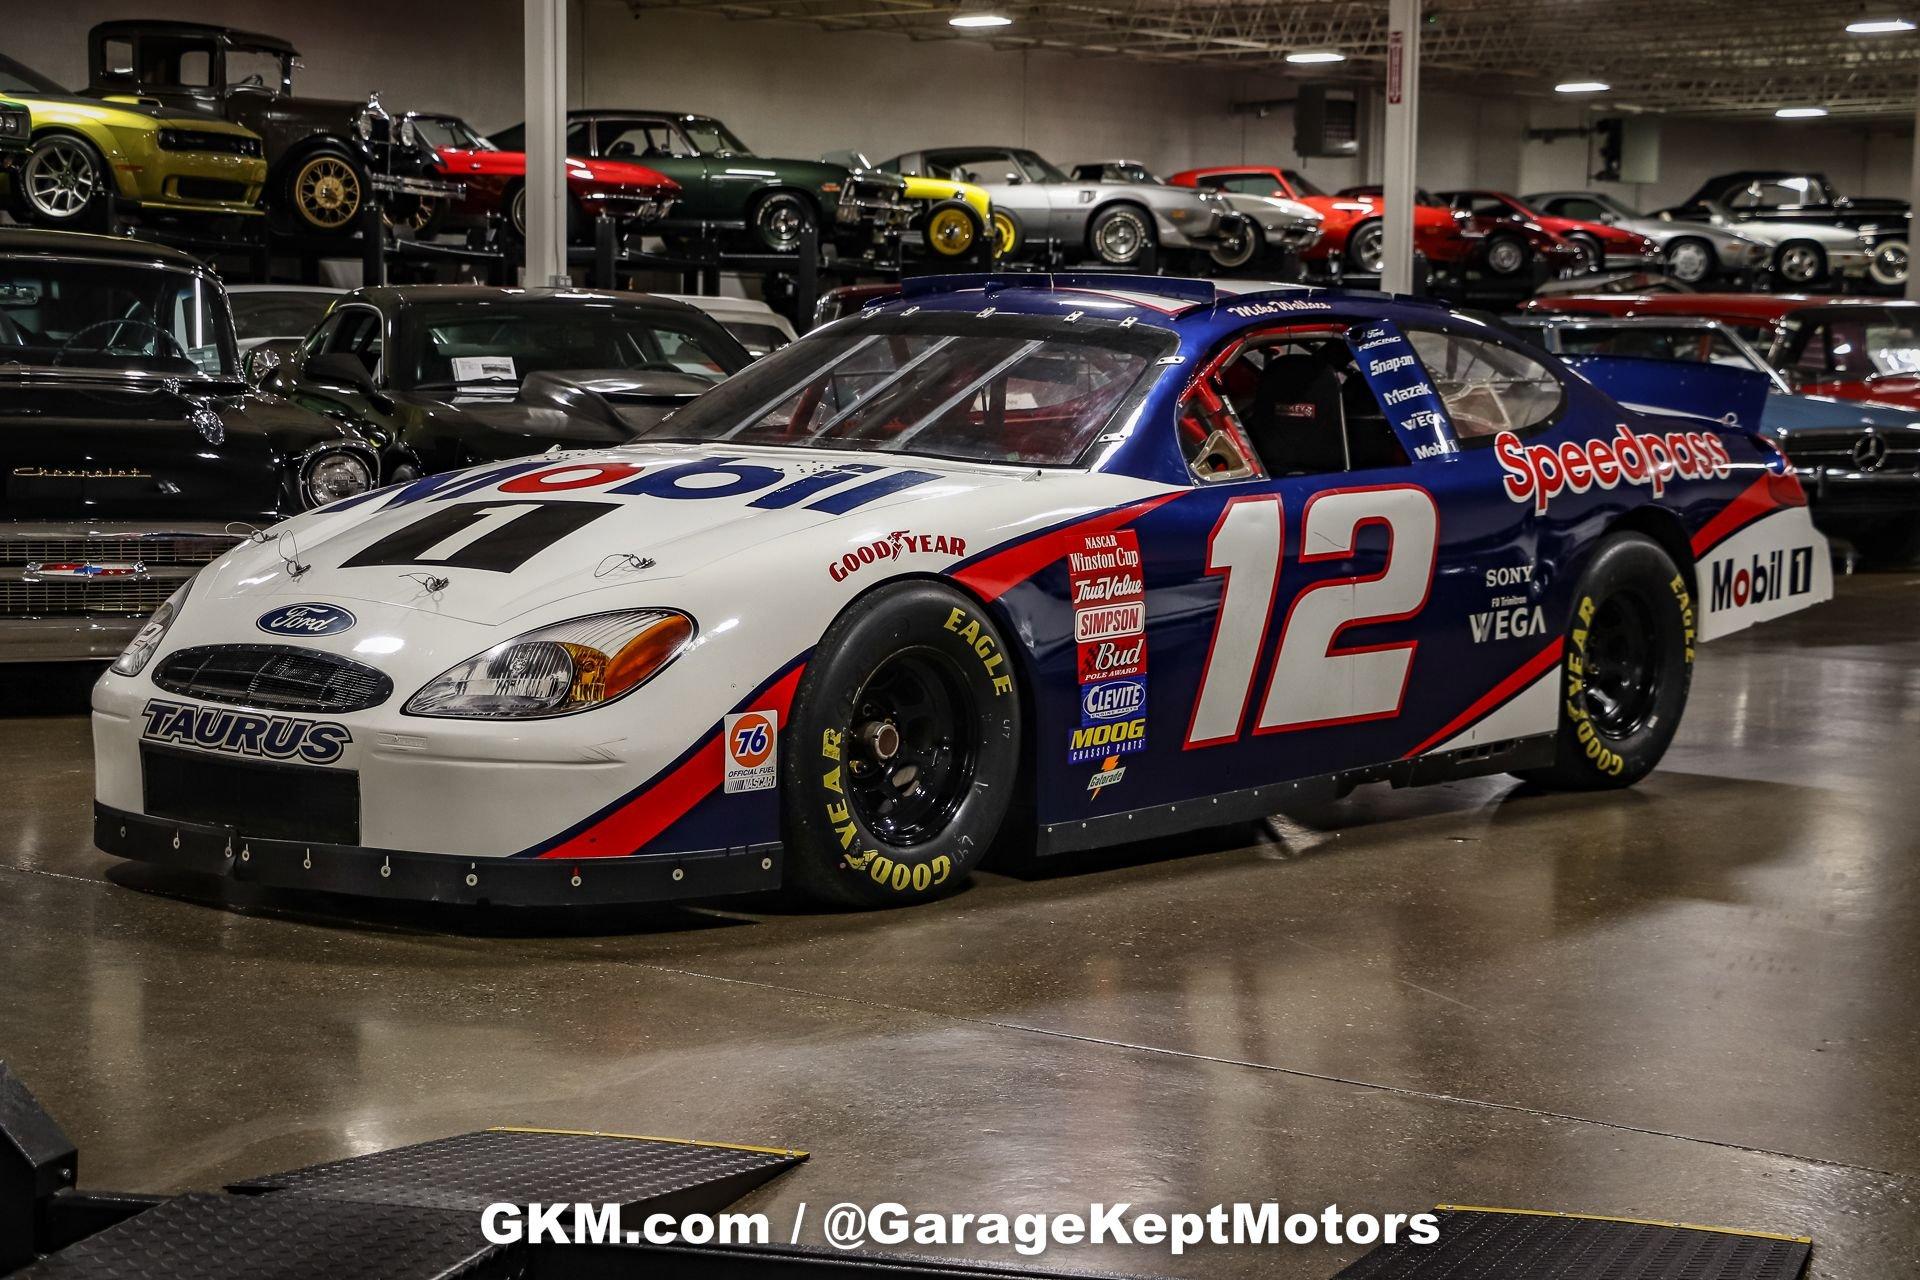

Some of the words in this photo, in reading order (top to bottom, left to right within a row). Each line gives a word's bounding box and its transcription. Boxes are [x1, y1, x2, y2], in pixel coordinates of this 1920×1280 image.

[1358, 336, 1401, 351] RACING
[1366, 328, 1385, 338] Ford
[1369, 355, 1415, 376] Snap-on
[1383, 382, 1433, 406] Mazak
[13, 466, 152, 478] Chevrolet
[1495, 423, 1732, 517] Speedpass
[312, 458, 946, 516] Mobil
[1084, 534, 1118, 550] NASCAR
[1069, 552, 1116, 573] Winston
[1115, 547, 1139, 568] Cup
[1486, 565, 1534, 588] SONY
[1710, 549, 1784, 613] Mobil
[270, 606, 339, 632] Ford
[1080, 607, 1140, 637] SIMPSON
[1182, 483, 1440, 751] 12
[1469, 605, 1547, 644] WEGA
[1669, 573, 1696, 664] EAGLE
[943, 606, 1014, 697] EAGLE
[1095, 638, 1144, 671] Bud
[1084, 671, 1108, 681] POLE
[1108, 667, 1138, 677] AWARD
[142, 698, 354, 765] TAURUS
[735, 722, 769, 758] 76
[1069, 718, 1146, 751] MOOG
[1072, 745, 1111, 761] CHASSIS
[1115, 739, 1143, 753] PARTS
[728, 768, 758, 778] OFFICIAL
[758, 766, 775, 774] FUEL
[1090, 770, 1122, 788] Gatorade
